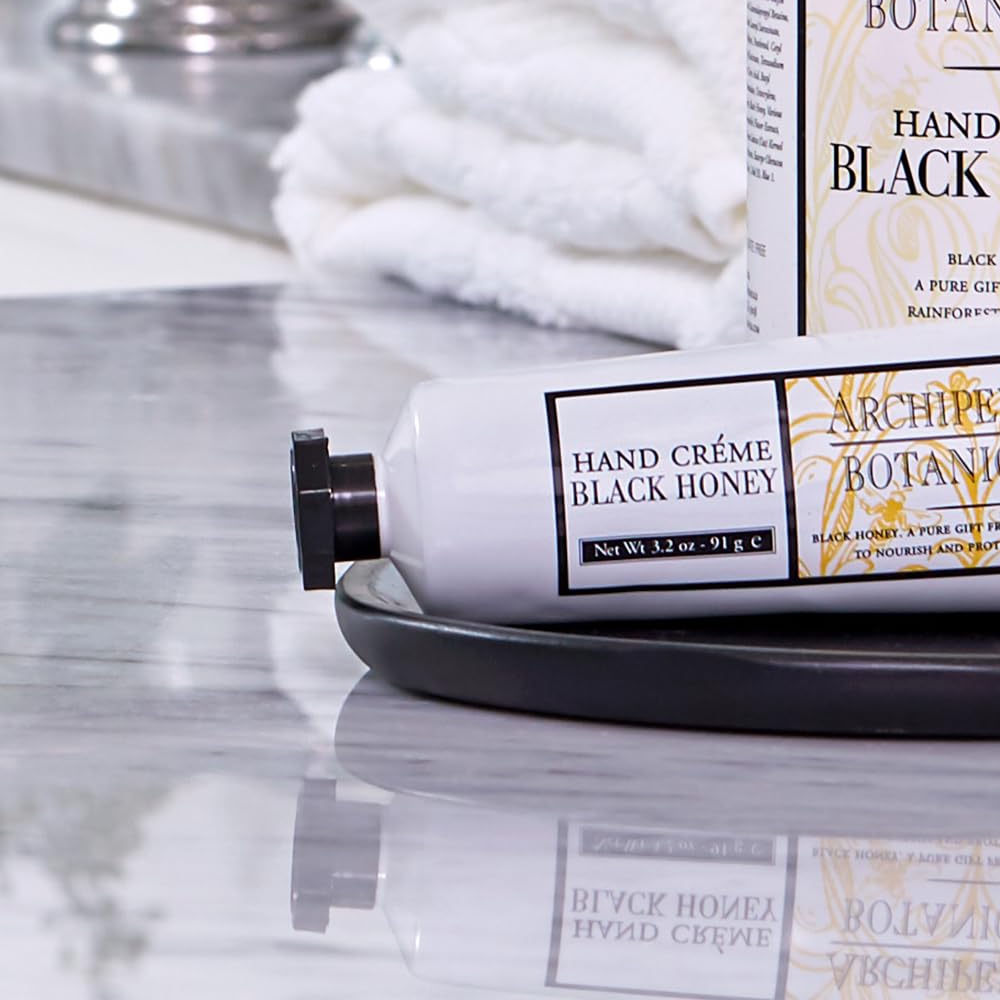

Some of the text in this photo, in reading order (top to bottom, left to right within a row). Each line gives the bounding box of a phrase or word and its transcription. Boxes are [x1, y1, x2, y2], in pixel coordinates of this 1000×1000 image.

[830, 142, 991, 199] BLACK
[947, 253, 996, 266] BLACK
[914, 279, 924, 291] A
[929, 280, 969, 292] PURE
[572, 433, 773, 474] HAND CRÉME
[571, 467, 778, 507] BLACK HONEY
[812, 531, 851, 544] BLACK
[855, 528, 903, 541] HONEY.
[906, 526, 915, 537] A
[918, 524, 952, 536] PURE
[954, 522, 984, 534] GIFT
[594, 542, 620, 558] Net
[624, 539, 648, 555] Wt
[651, 538, 674, 553] 3.2
[678, 540, 695, 552] oz
[710, 536, 727, 550] 91
[733, 537, 744, 551] g
[854, 548, 873, 559] TO
[875, 545, 933, 559] NOURISH
[937, 542, 964, 555] AND
